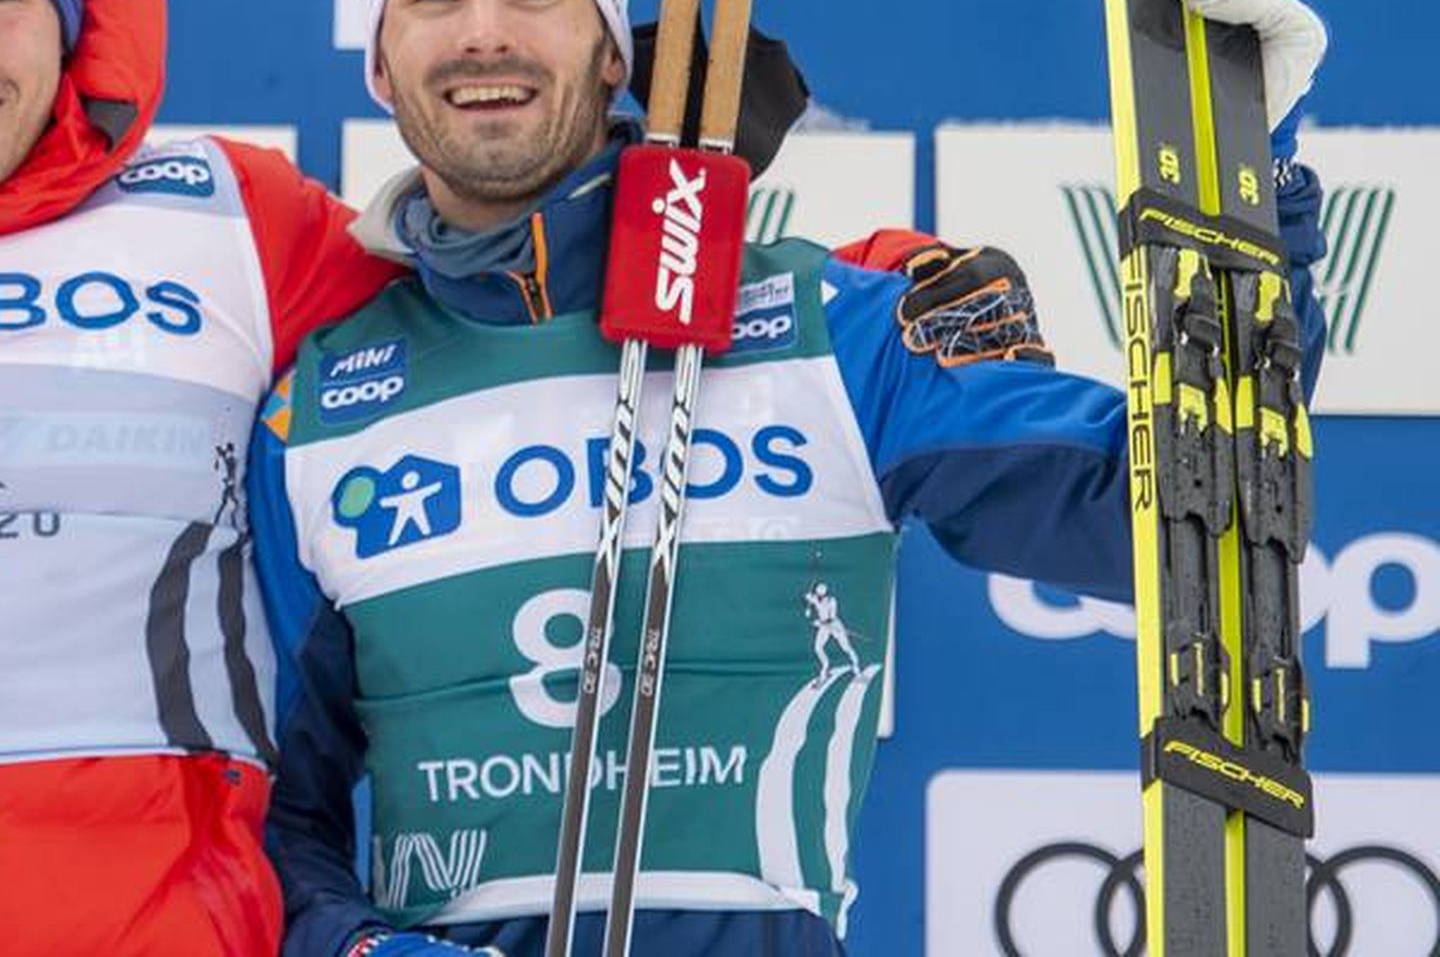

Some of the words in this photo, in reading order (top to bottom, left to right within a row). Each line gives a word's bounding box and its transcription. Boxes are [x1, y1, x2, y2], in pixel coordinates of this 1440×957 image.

[119, 156, 210, 185] coop
[1139, 207, 1280, 266] FISCHER
[730, 315, 792, 340] oop
[329, 344, 397, 378] MINI
[321, 375, 404, 409] coop
[494, 426, 813, 518] OBOS
[508, 589, 622, 728] 8
[417, 746, 747, 802] TRONDHEIM
[1164, 740, 1306, 810] FISCHER
